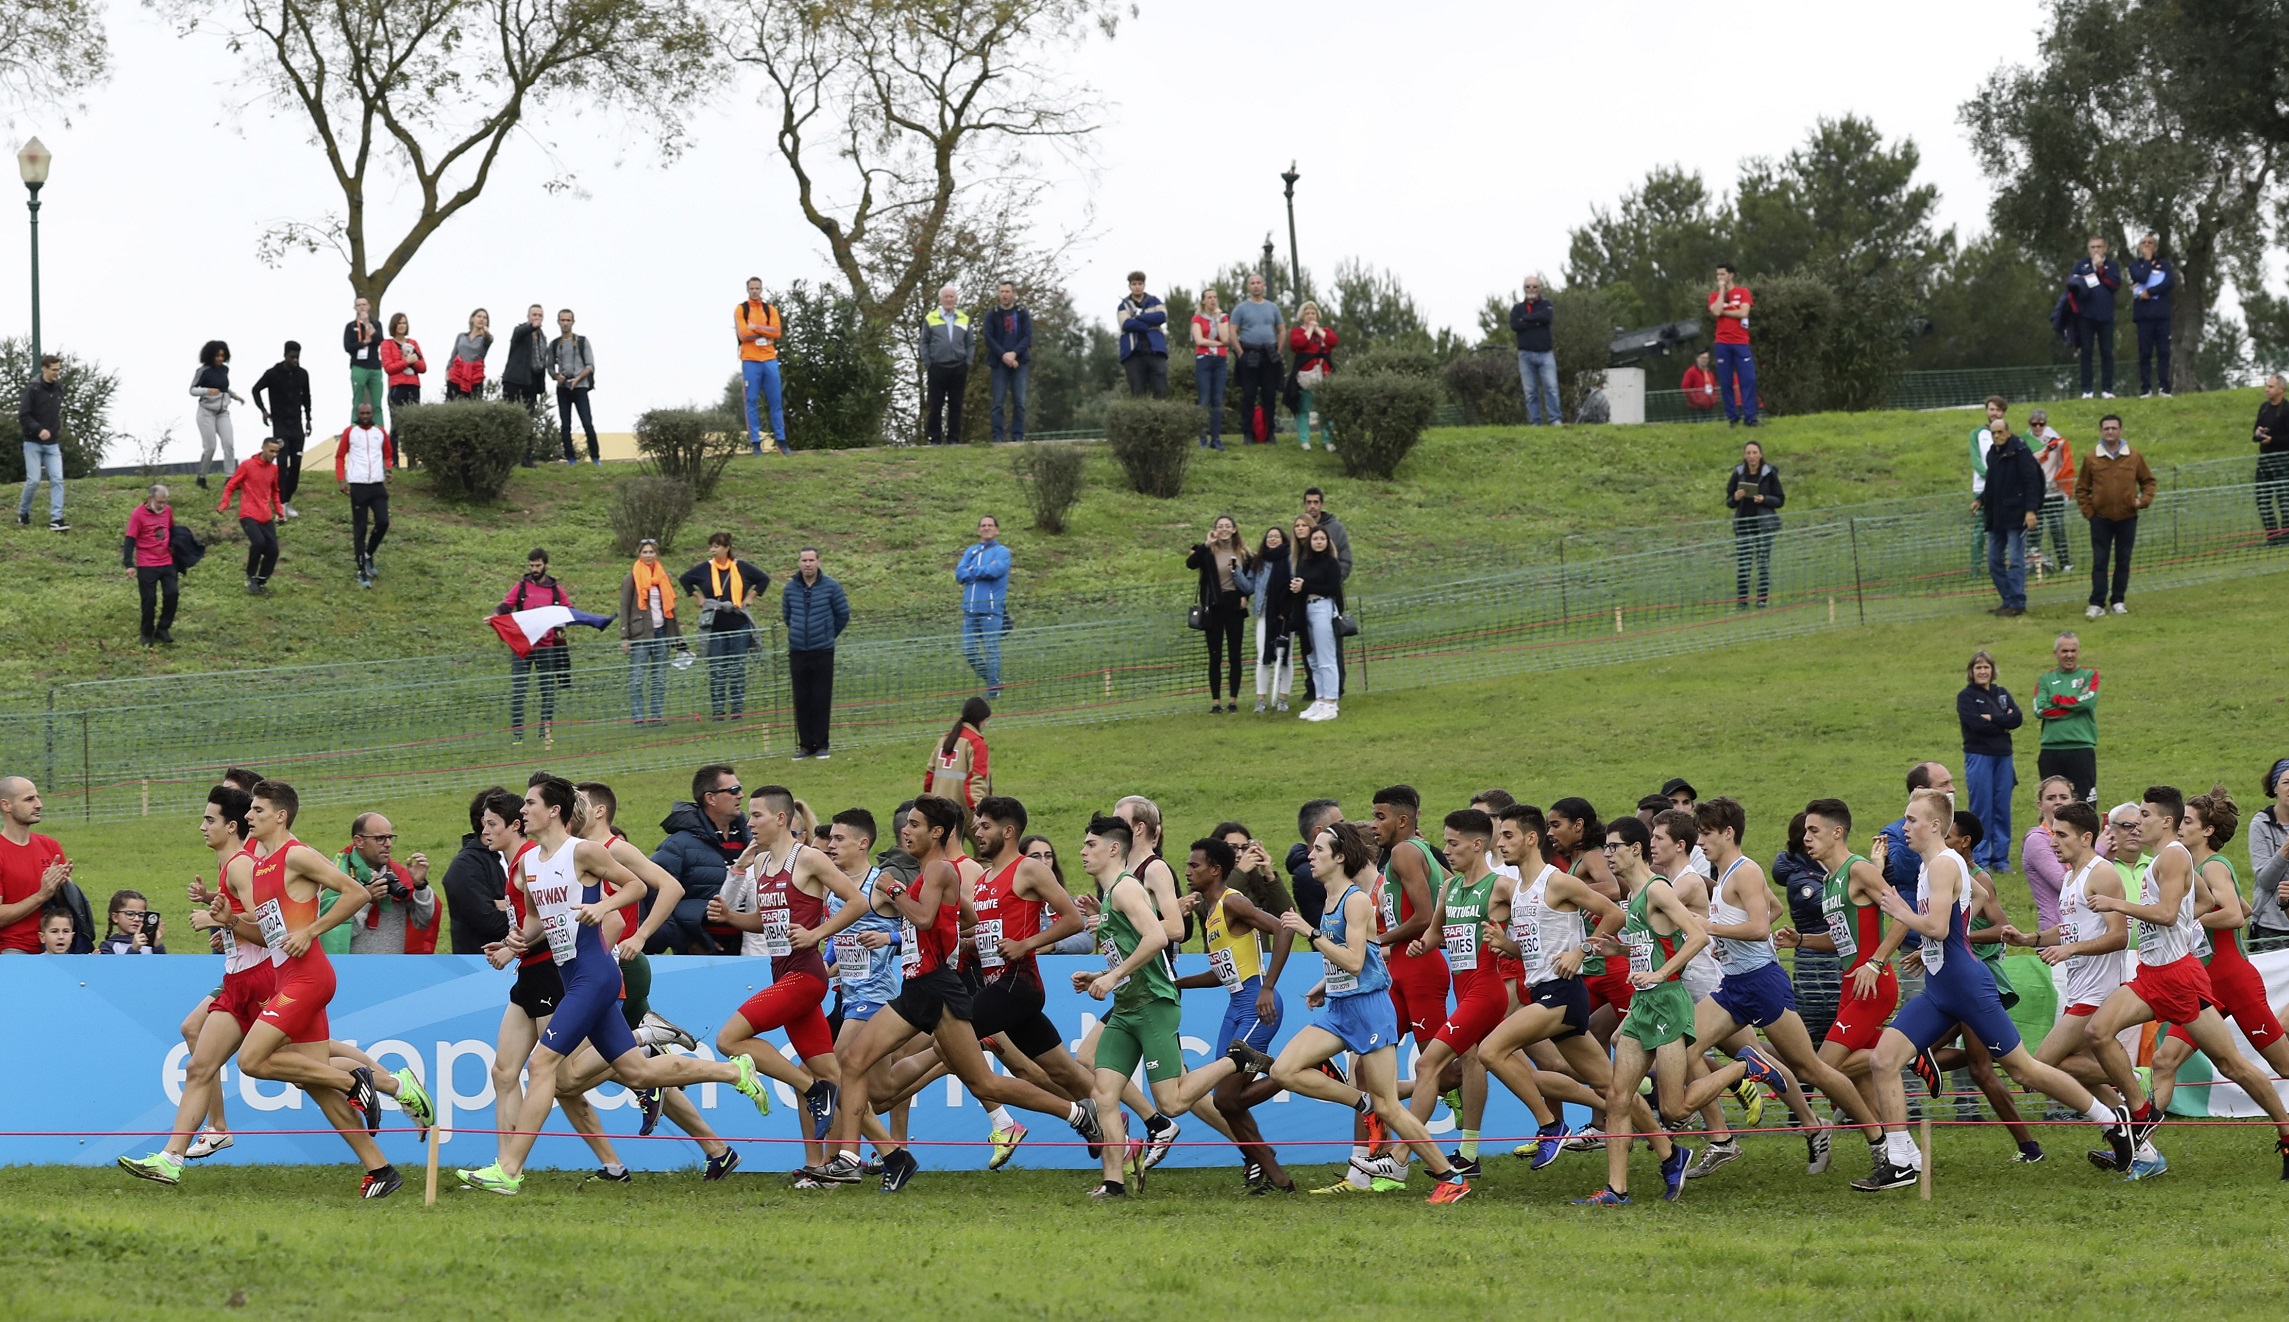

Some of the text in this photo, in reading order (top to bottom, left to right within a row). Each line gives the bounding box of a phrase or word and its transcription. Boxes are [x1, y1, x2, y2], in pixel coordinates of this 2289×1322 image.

[532, 886, 568, 907] ORWAY
[758, 891, 788, 908] CROATIA
[255, 904, 269, 920] PAR
[761, 912, 778, 923] PAR
[1384, 907, 1394, 922] OS
[1446, 904, 1481, 918] PORTUGAL
[975, 922, 990, 933] PAR
[1515, 925, 1530, 936] PAR
[2138, 921, 2157, 936] SKI
[833, 935, 855, 945] SPAR
[1447, 938, 1473, 954] OMES
[1209, 953, 1222, 965] AR
